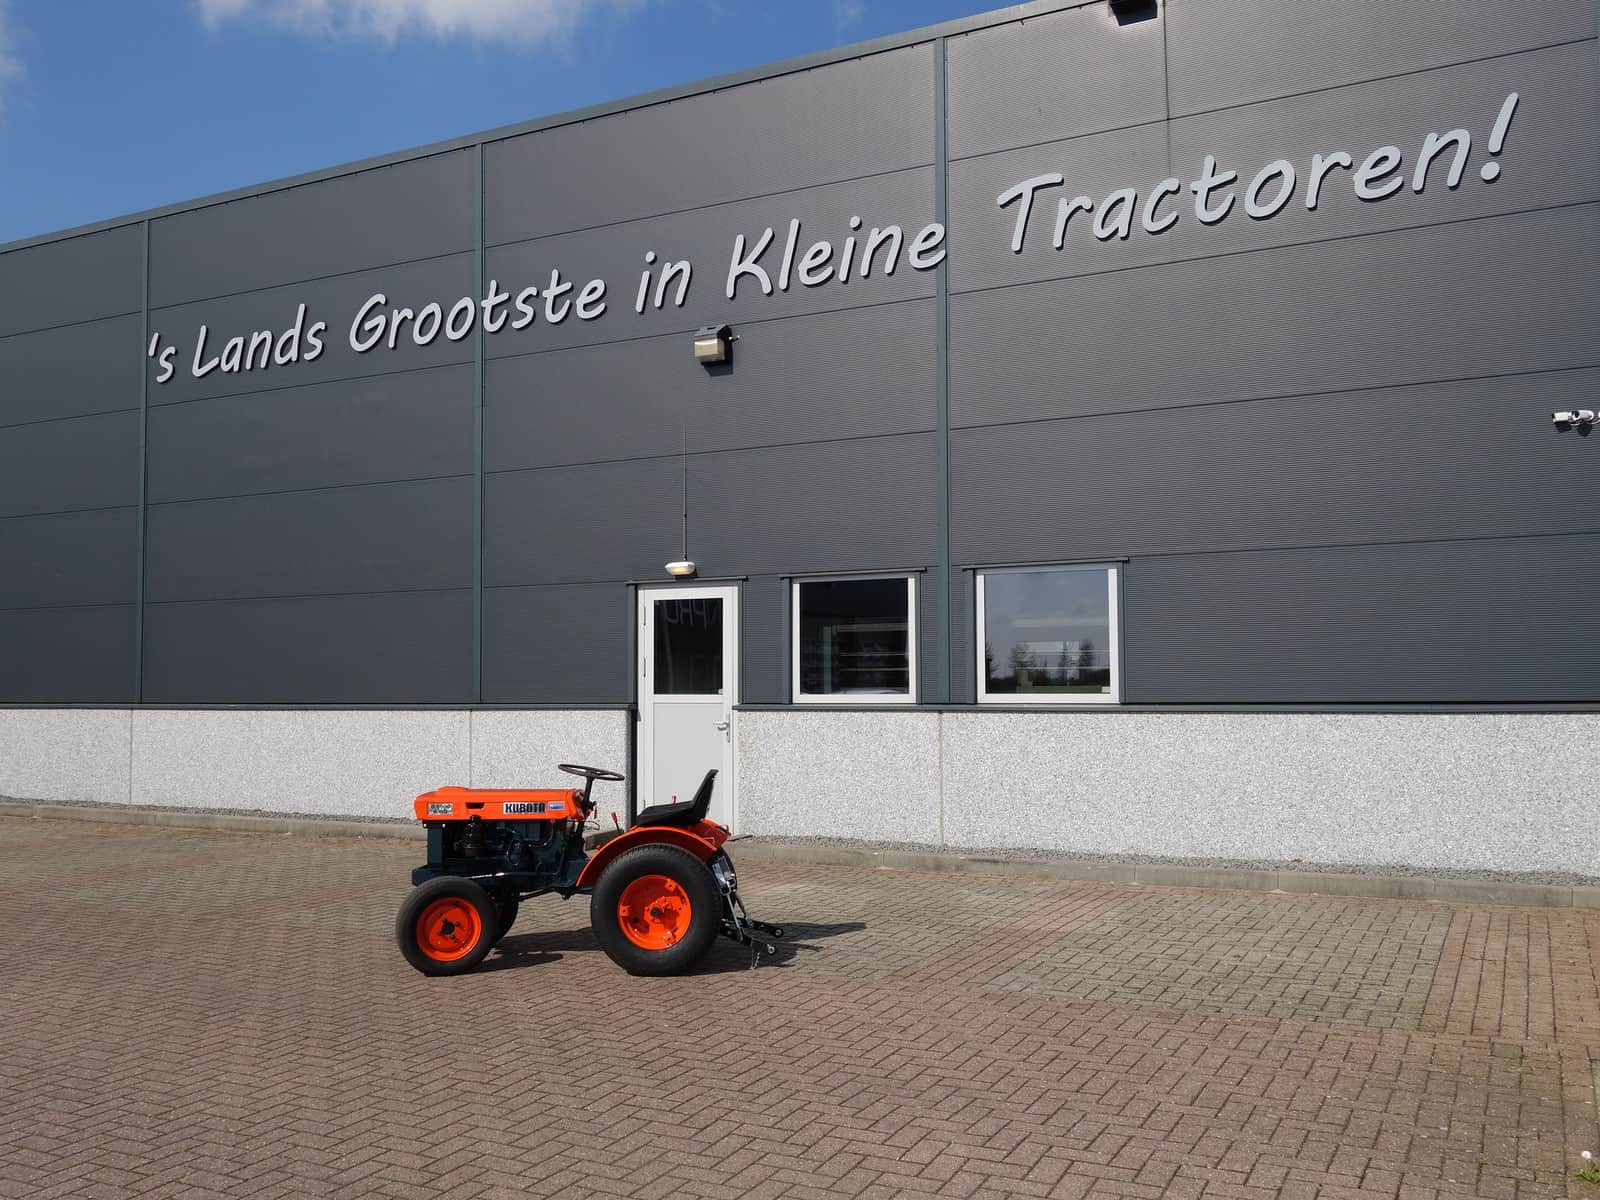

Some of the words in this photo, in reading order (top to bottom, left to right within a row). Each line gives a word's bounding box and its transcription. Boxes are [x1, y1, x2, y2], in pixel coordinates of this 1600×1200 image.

[148, 332, 177, 384] 's
[191, 303, 327, 379] Lands
[348, 268, 607, 354] Grootste
[635, 250, 692, 314] in
[725, 215, 948, 299] Kleine
[997, 92, 1519, 254] Tractoren!
[504, 802, 546, 814] KUBOTA
